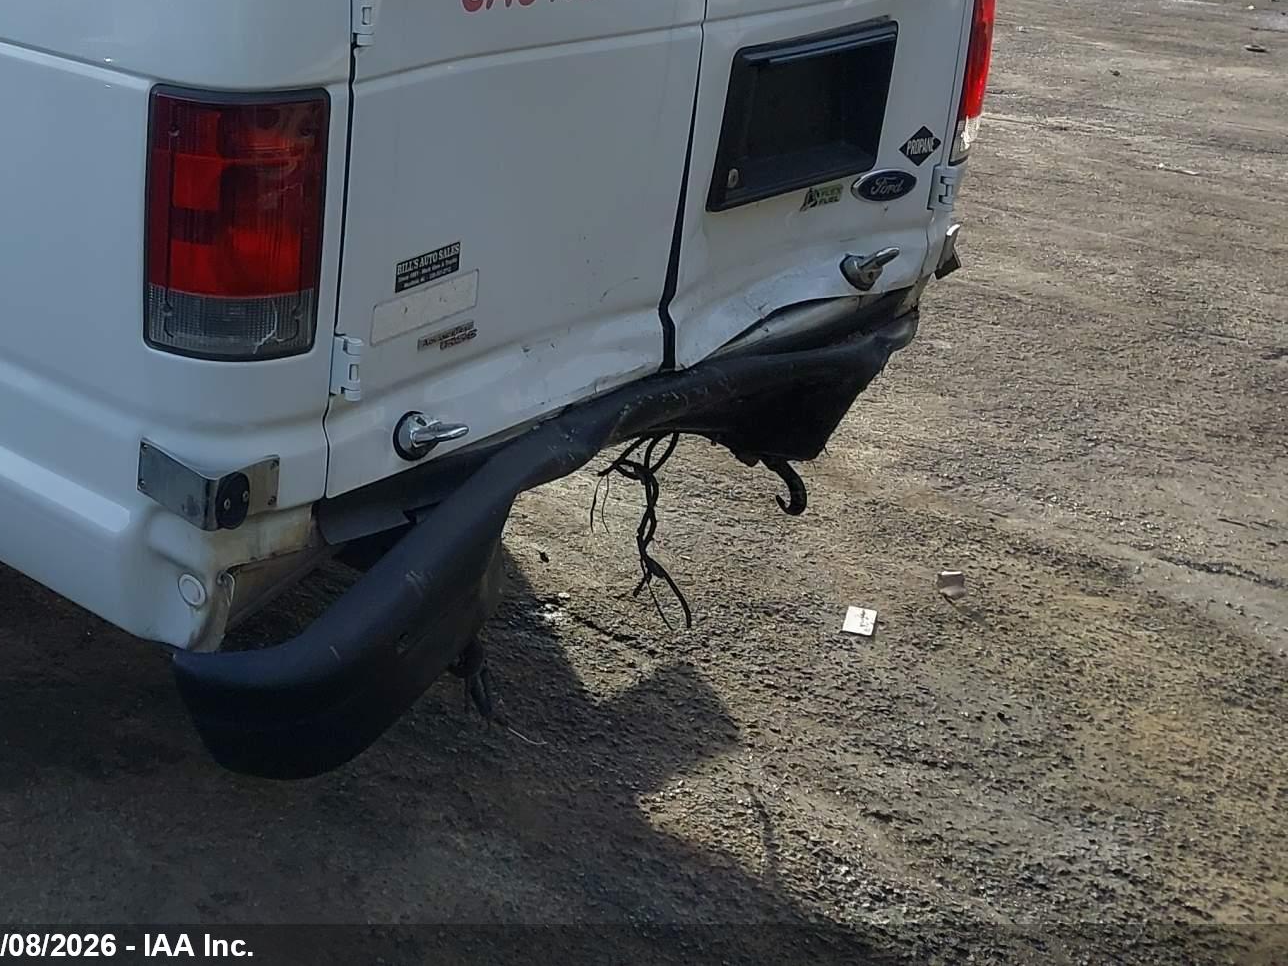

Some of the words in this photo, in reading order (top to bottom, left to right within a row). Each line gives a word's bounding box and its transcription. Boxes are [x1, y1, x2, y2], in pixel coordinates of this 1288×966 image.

[906, 136, 935, 156] PROPANE
[871, 177, 904, 195] Ford
[419, 251, 438, 268] AUTO
[438, 243, 460, 258] SALES
